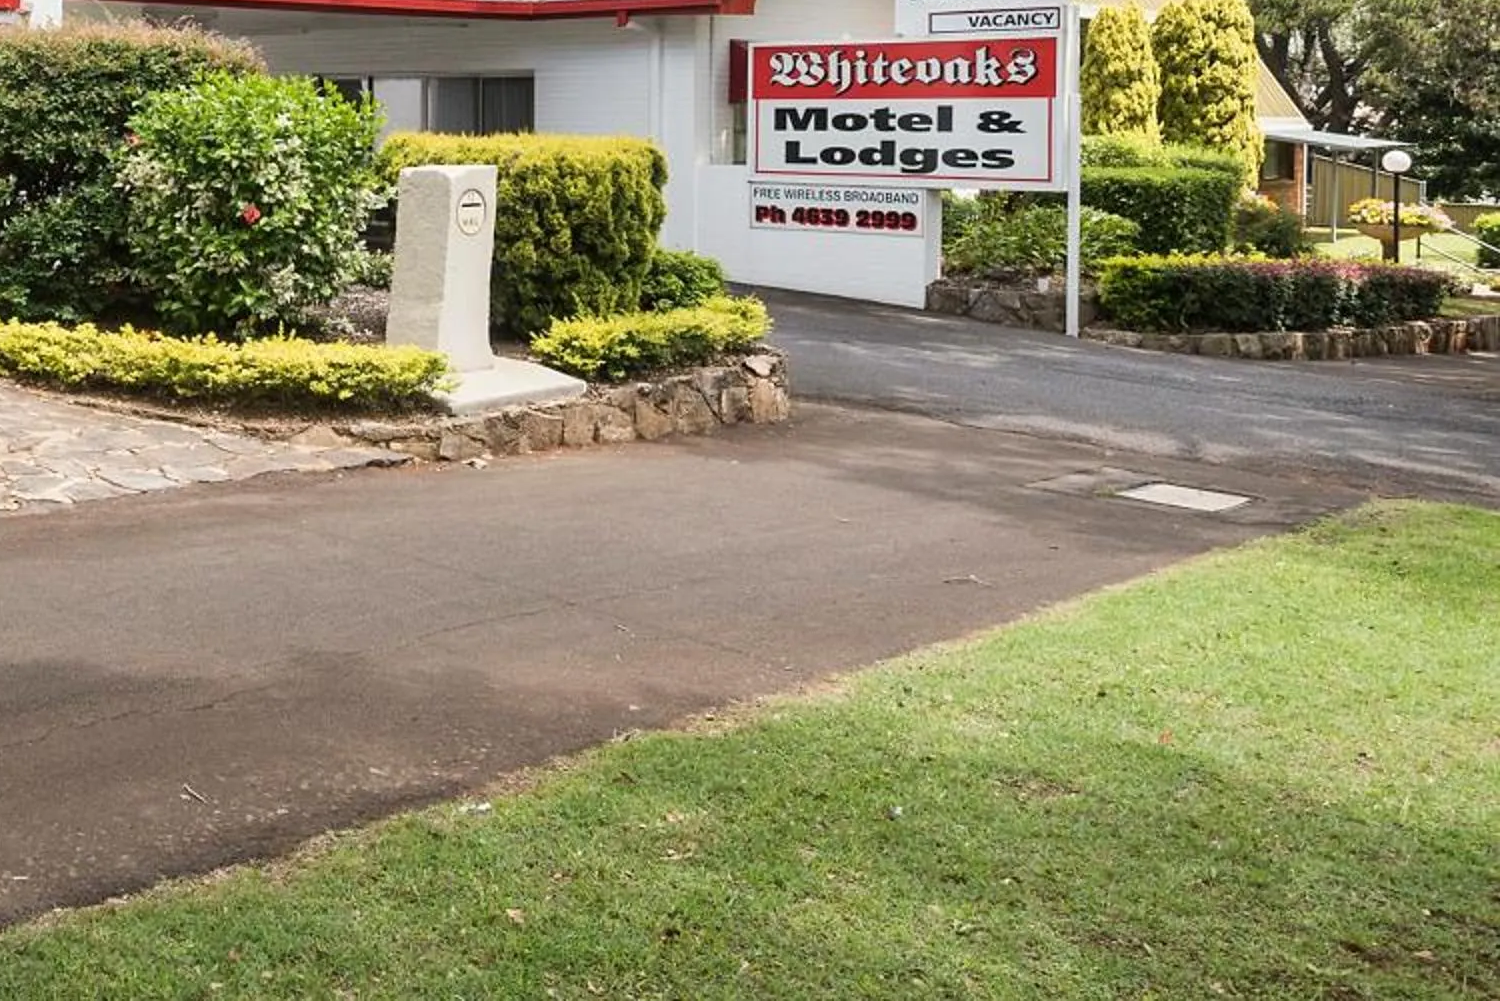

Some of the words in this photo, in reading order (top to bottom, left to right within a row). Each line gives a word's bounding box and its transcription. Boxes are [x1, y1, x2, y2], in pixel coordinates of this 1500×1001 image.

[968, 12, 1055, 28] VACANCY
[773, 105, 954, 133] Motel
[976, 110, 1027, 134] &
[785, 139, 1015, 174] Lodges
[753, 187, 781, 200] FREE
[783, 189, 841, 201] WIRELESS
[844, 190, 919, 204] BROADBAND
[755, 204, 786, 224] Ph
[791, 206, 849, 227] 4639
[855, 209, 918, 231] 2999
